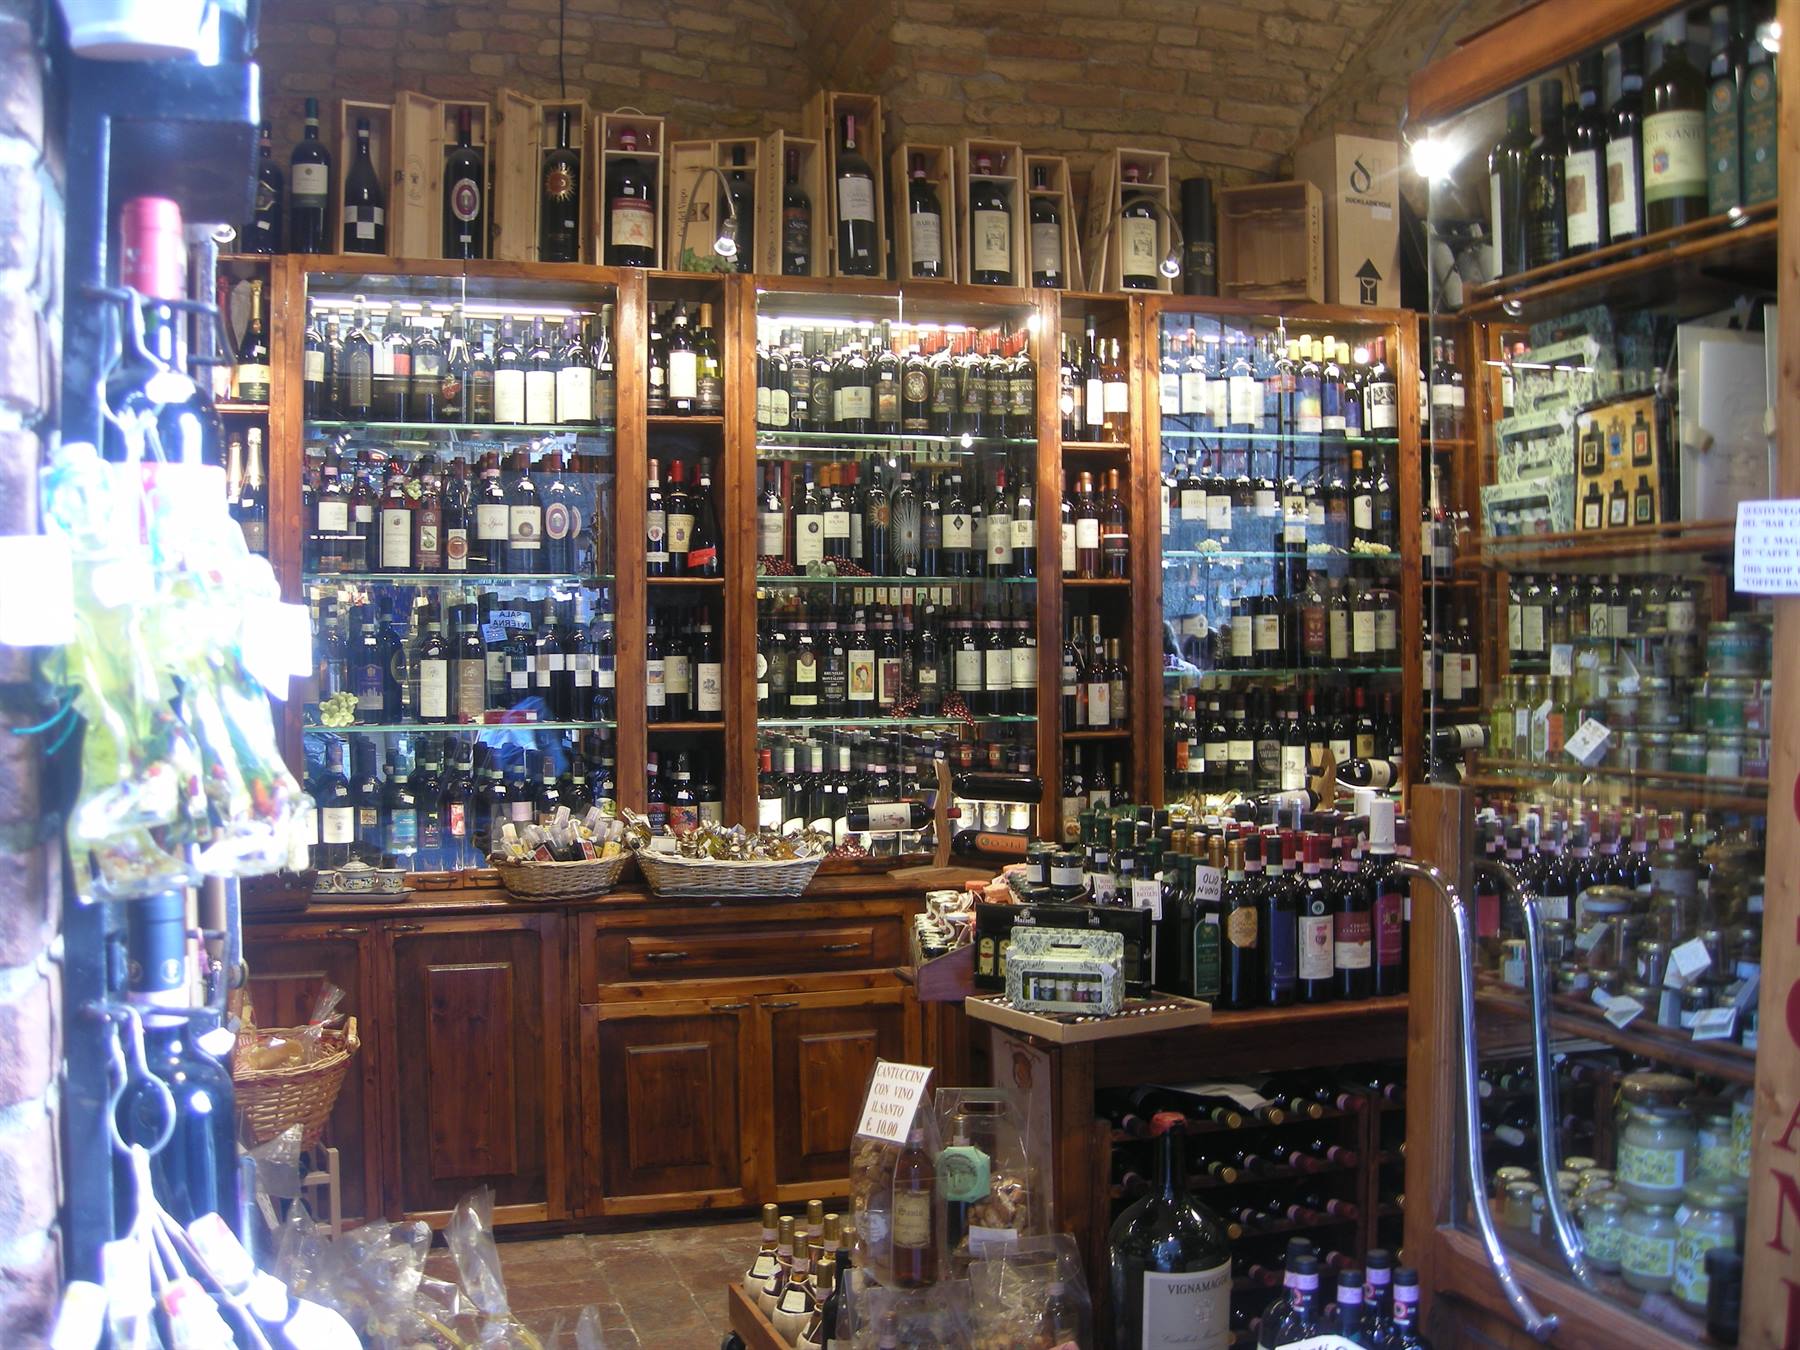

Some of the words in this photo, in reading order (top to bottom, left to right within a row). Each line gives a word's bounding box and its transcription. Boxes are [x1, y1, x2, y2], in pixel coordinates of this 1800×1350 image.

[1202, 872, 1220, 885] OLIO
[877, 1065, 925, 1083] CANTUCCINI
[874, 1082, 889, 1096] CON
[894, 1085, 914, 1102] VINO
